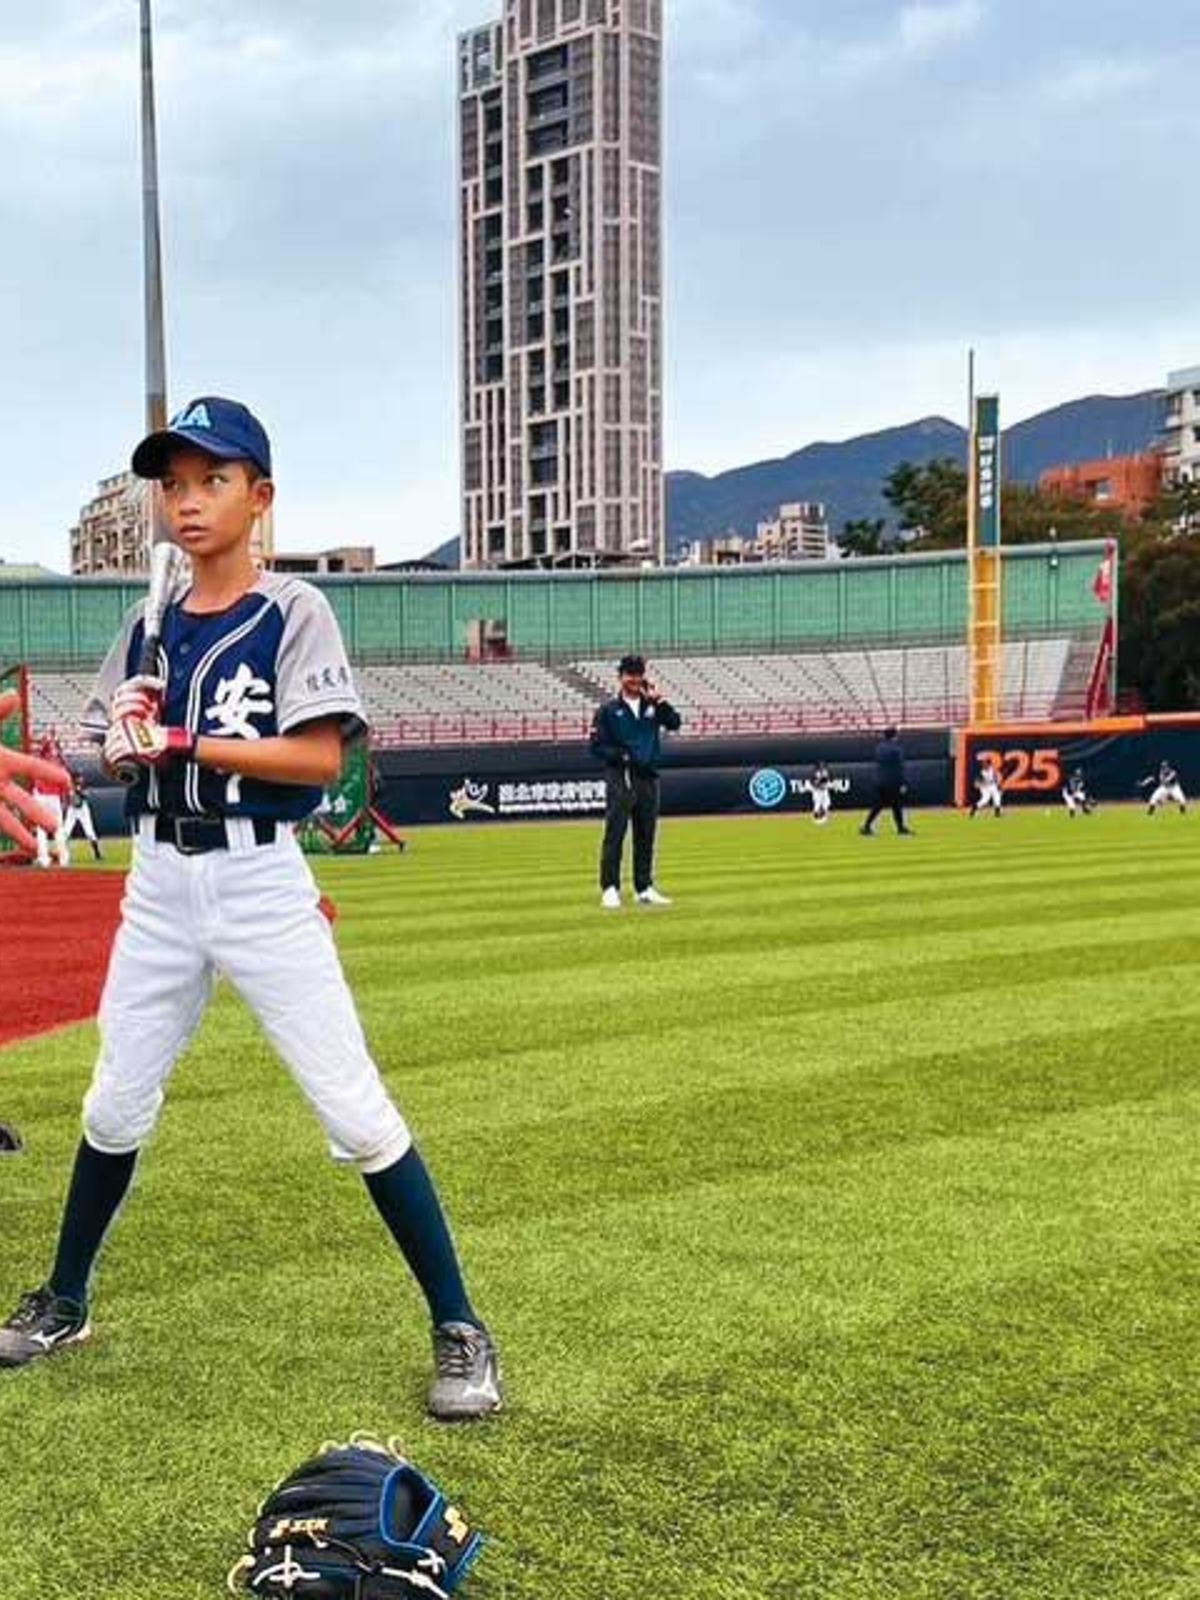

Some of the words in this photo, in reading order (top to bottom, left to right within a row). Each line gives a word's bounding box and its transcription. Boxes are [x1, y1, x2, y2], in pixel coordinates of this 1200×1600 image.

[205, 662, 273, 740] 安
[790, 779, 850, 793] TIAMU
[976, 748, 1060, 790] 325
